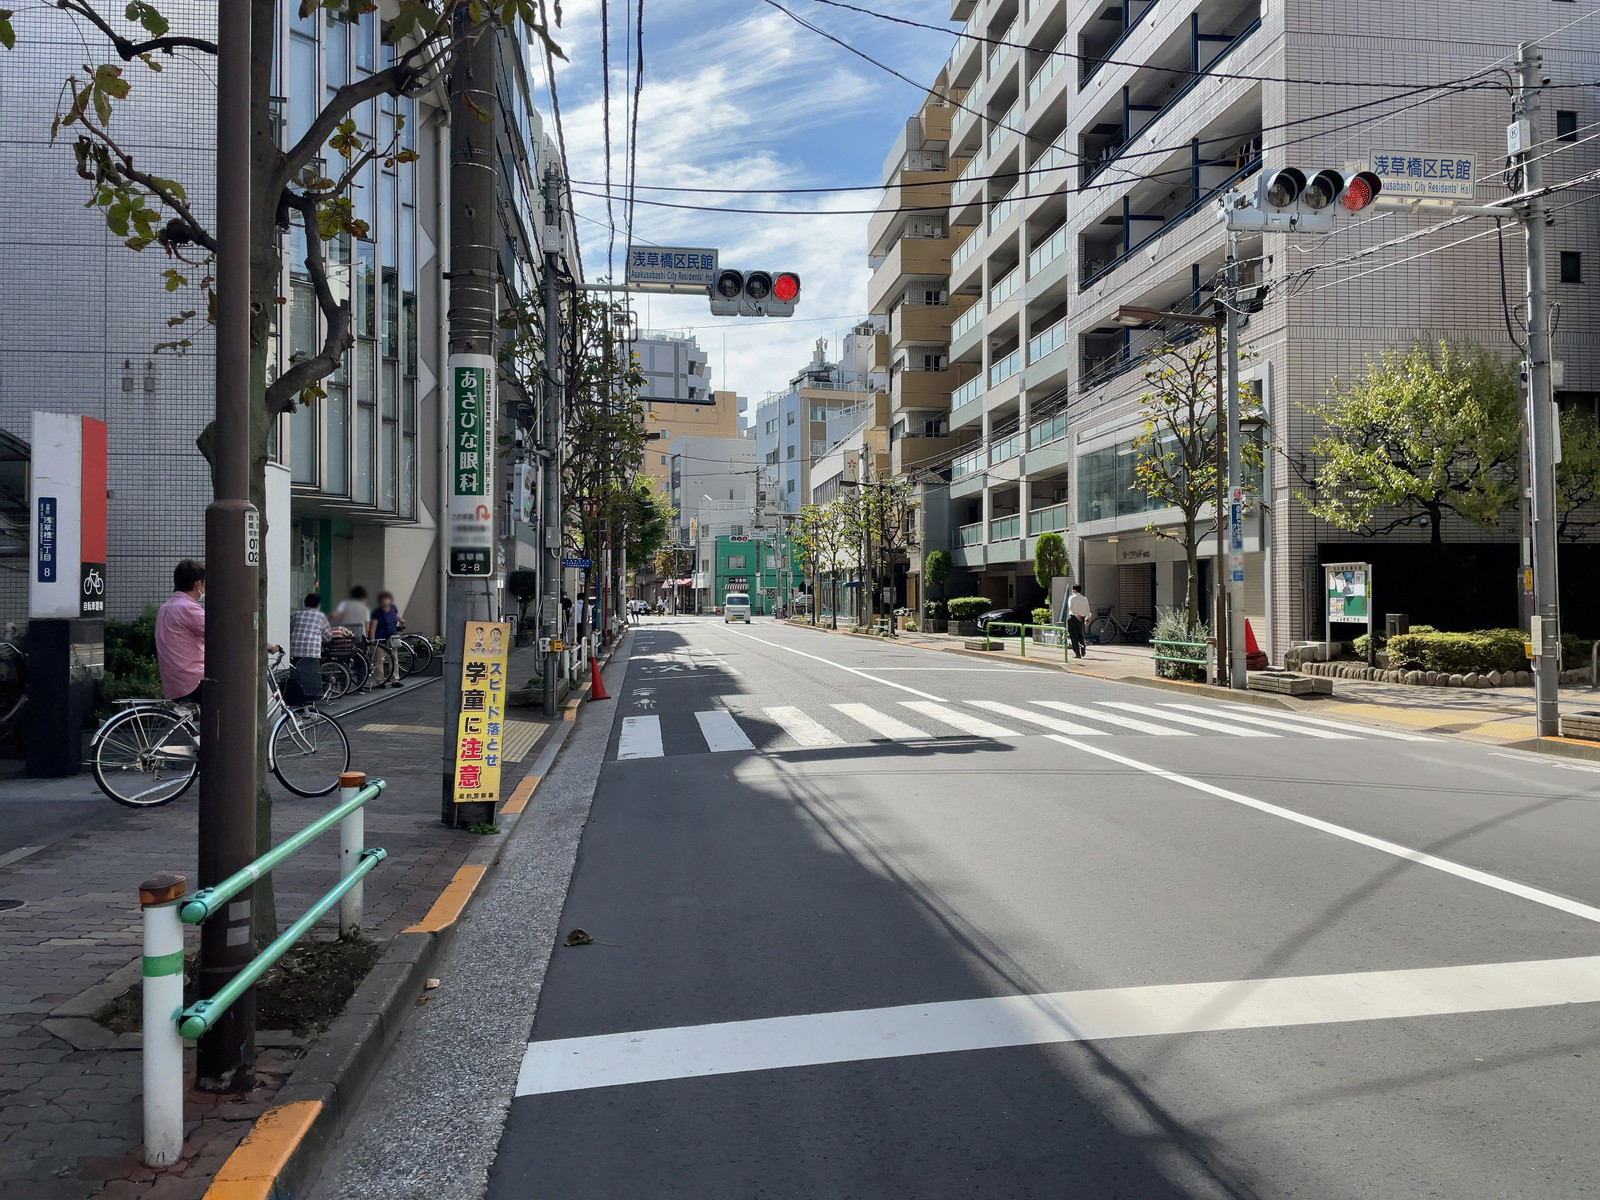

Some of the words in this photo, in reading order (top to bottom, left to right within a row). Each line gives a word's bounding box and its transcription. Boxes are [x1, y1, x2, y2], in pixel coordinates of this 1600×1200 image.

[1374, 155, 1471, 180] 浅草橋区民館
[1382, 180, 1413, 192] kusabashi
[1414, 181, 1427, 194] City
[1428, 183, 1460, 194] Residents'
[1460, 184, 1473, 195] Hall
[633, 251, 714, 270] 浅草橋区民館
[631, 270, 666, 280] Asakusabashi
[666, 272, 677, 282] City
[678, 272, 704, 282] Residents'
[705, 273, 713, 282] Ha
[459, 370, 479, 492] あさひな眼科
[43, 516, 51, 562] 浅草橋二丁目
[457, 552, 484, 562] 浅草橋
[43, 567, 51, 577] 8
[460, 563, 480, 572] 2-8
[484, 662, 503, 768] スピード落とせ
[457, 661, 487, 789] 学童に注意
